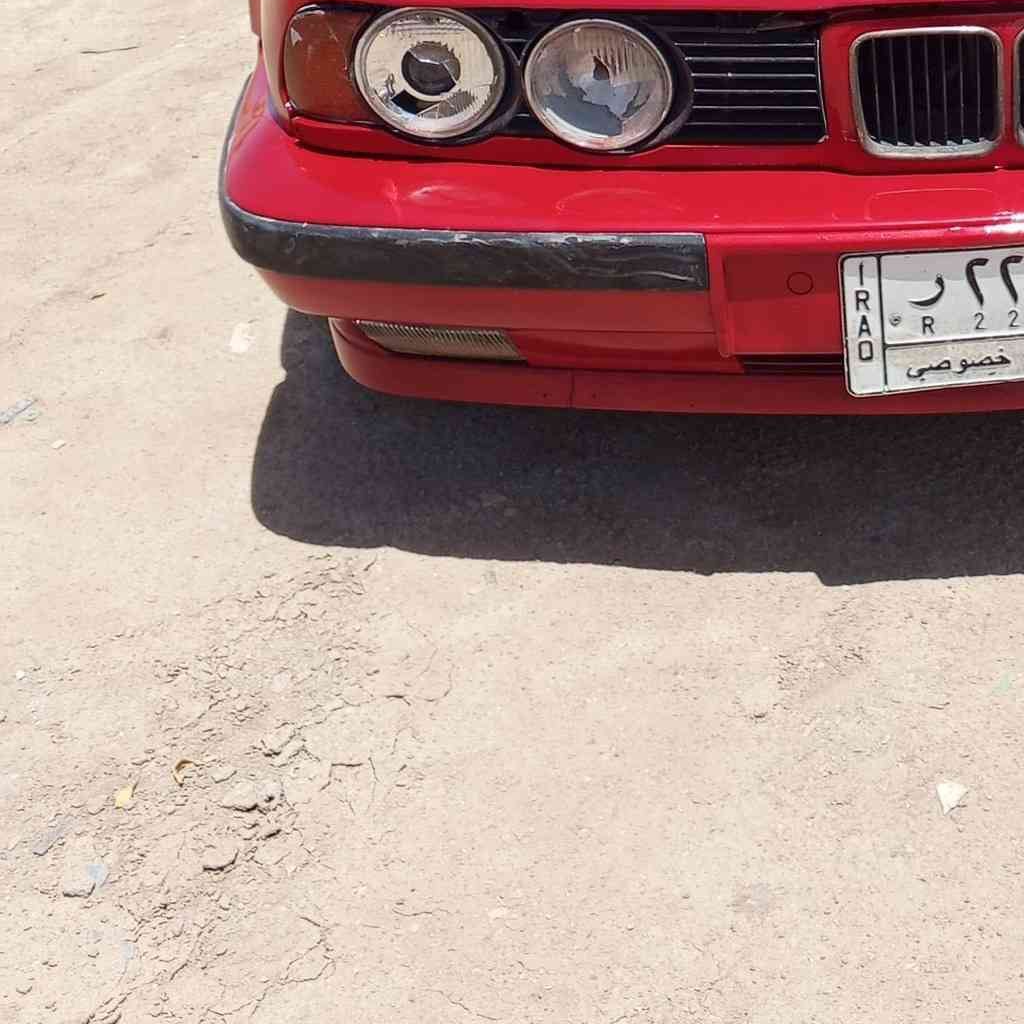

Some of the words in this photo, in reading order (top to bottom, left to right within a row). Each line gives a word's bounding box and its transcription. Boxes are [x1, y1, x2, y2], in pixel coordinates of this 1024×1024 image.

[854, 262, 874, 363] IRAQ
[921, 316, 935, 335] R
[906, 347, 1012, 381] خصوصي
